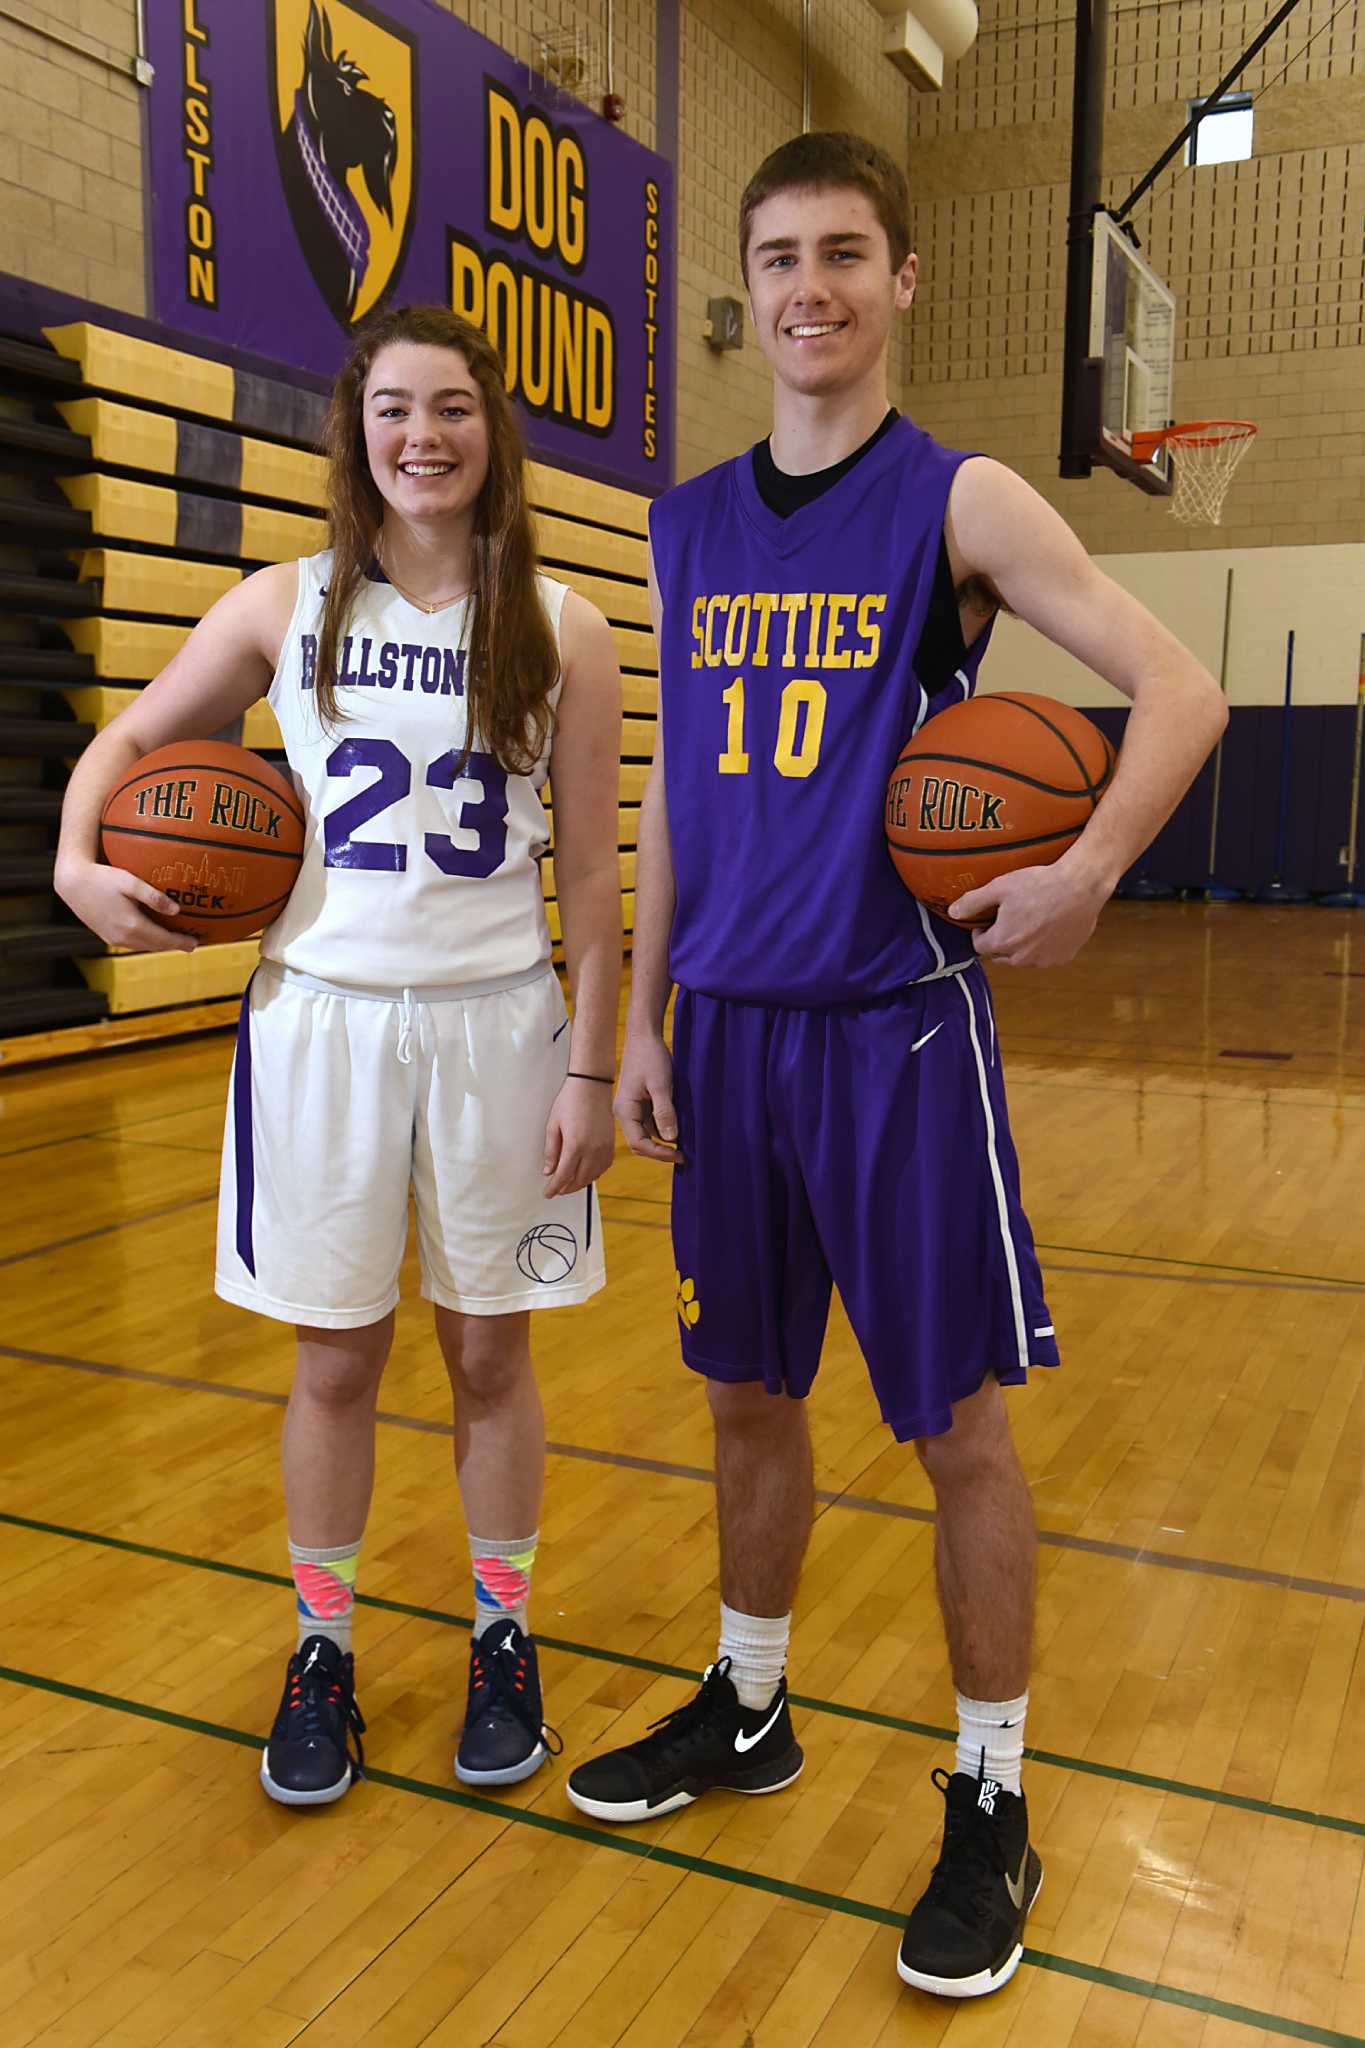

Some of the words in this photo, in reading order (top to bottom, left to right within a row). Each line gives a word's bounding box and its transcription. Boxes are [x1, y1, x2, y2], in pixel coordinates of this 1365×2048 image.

[488, 88, 586, 267] DOG
[451, 240, 613, 429] POUND
[644, 182, 658, 458] SCOTTIES
[301, 633, 467, 697] BLLSTON
[691, 592, 888, 670] SCOTTIES
[718, 676, 828, 778] 10
[134, 779, 199, 822] THE
[209, 781, 283, 839] ROCK
[323, 737, 509, 879] 23
[886, 776, 912, 830] HE
[918, 776, 1007, 832] ROCK
